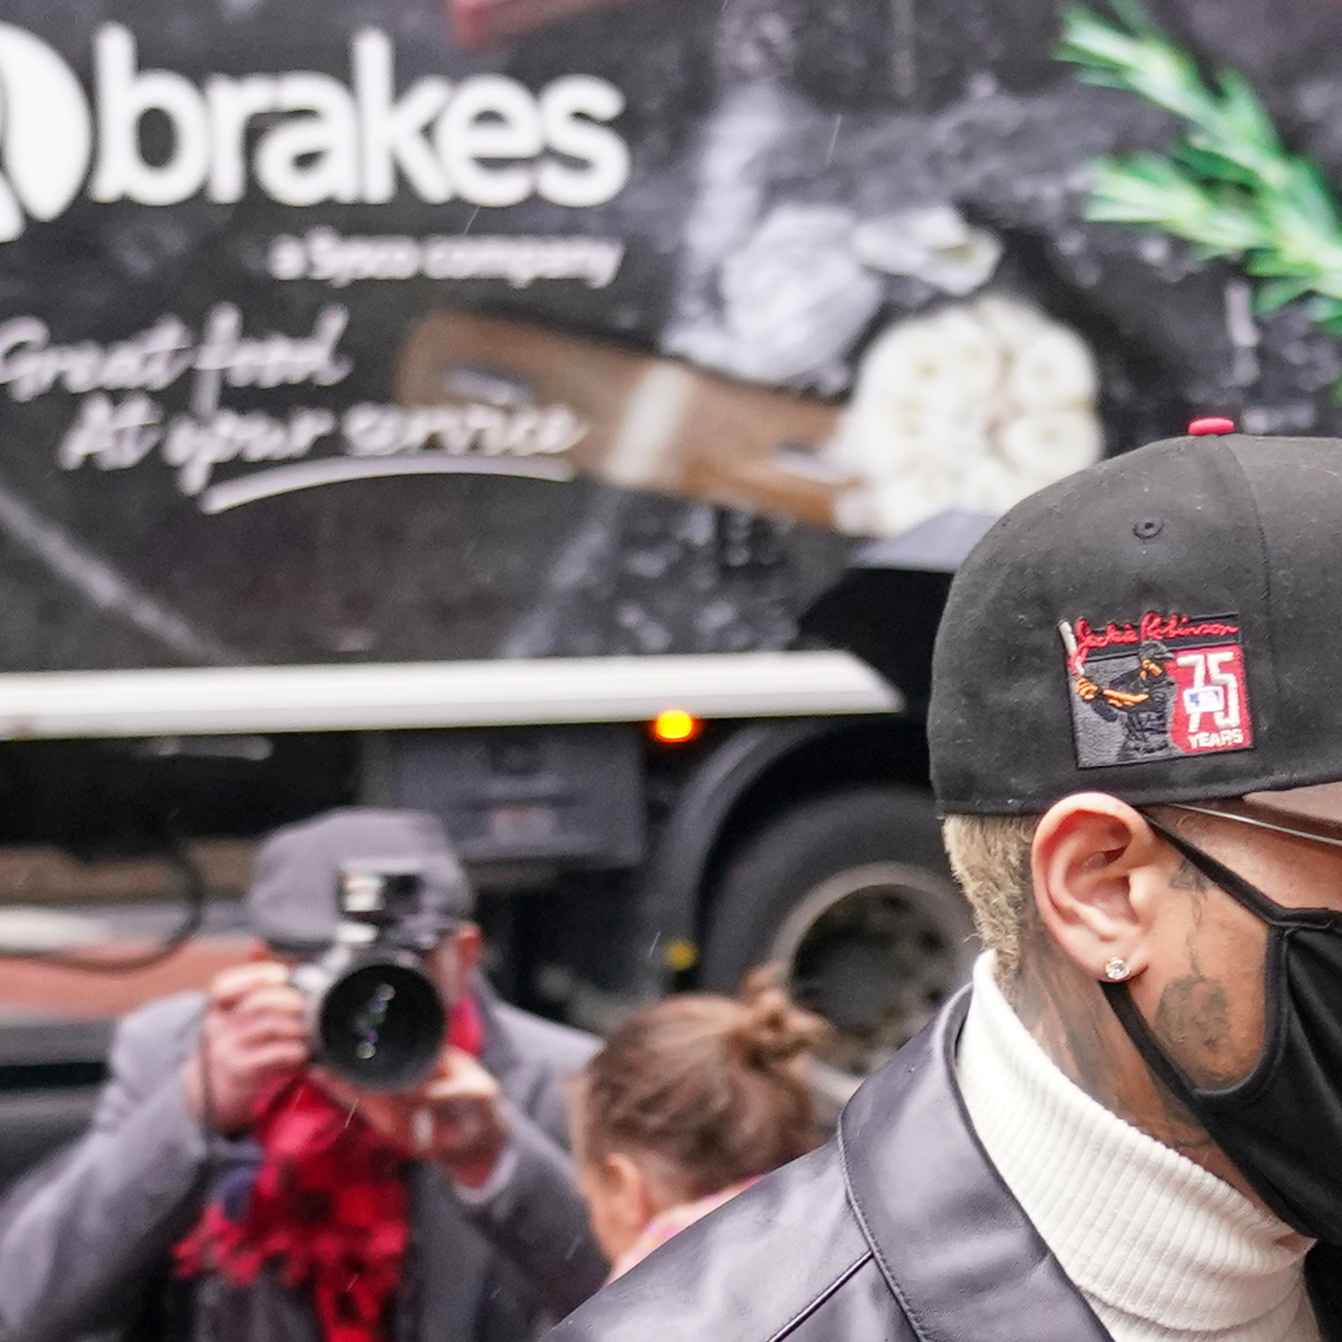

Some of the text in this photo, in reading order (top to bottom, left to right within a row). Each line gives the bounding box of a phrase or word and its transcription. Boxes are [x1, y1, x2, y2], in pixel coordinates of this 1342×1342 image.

[94, 22, 632, 207] brakes
[422, 234, 625, 288] company
[0, 302, 354, 416] Great food
[58, 394, 592, 496] At your service
[1140, 611, 1240, 644] Robinson
[1176, 651, 1240, 733] 75
[1188, 728, 1244, 750] YEARS
